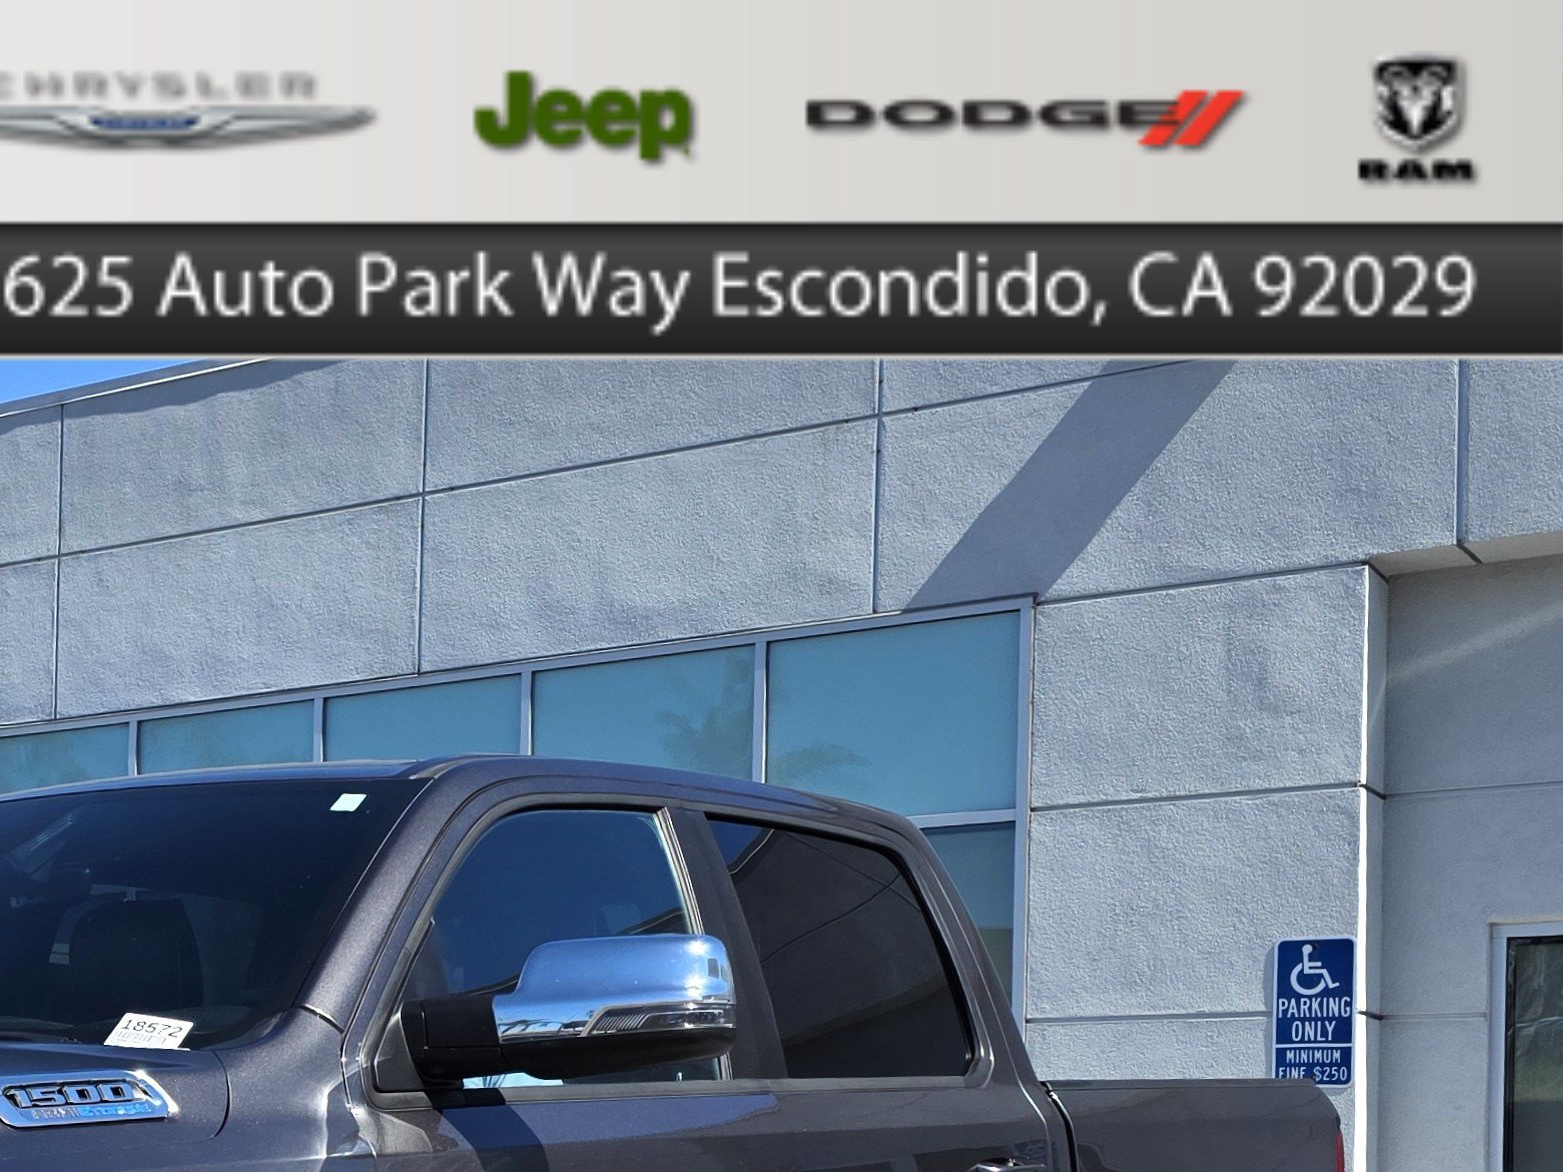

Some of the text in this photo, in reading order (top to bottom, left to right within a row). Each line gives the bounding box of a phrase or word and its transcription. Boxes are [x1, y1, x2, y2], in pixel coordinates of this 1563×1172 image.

[1278, 996, 1351, 1019] PARKING
[121, 1019, 183, 1038] 18572
[1291, 1020, 1336, 1041] ONLY
[1286, 1049, 1341, 1064] MINIMUM
[1313, 1065, 1348, 1082] $250
[7, 1081, 135, 1109] 1500
